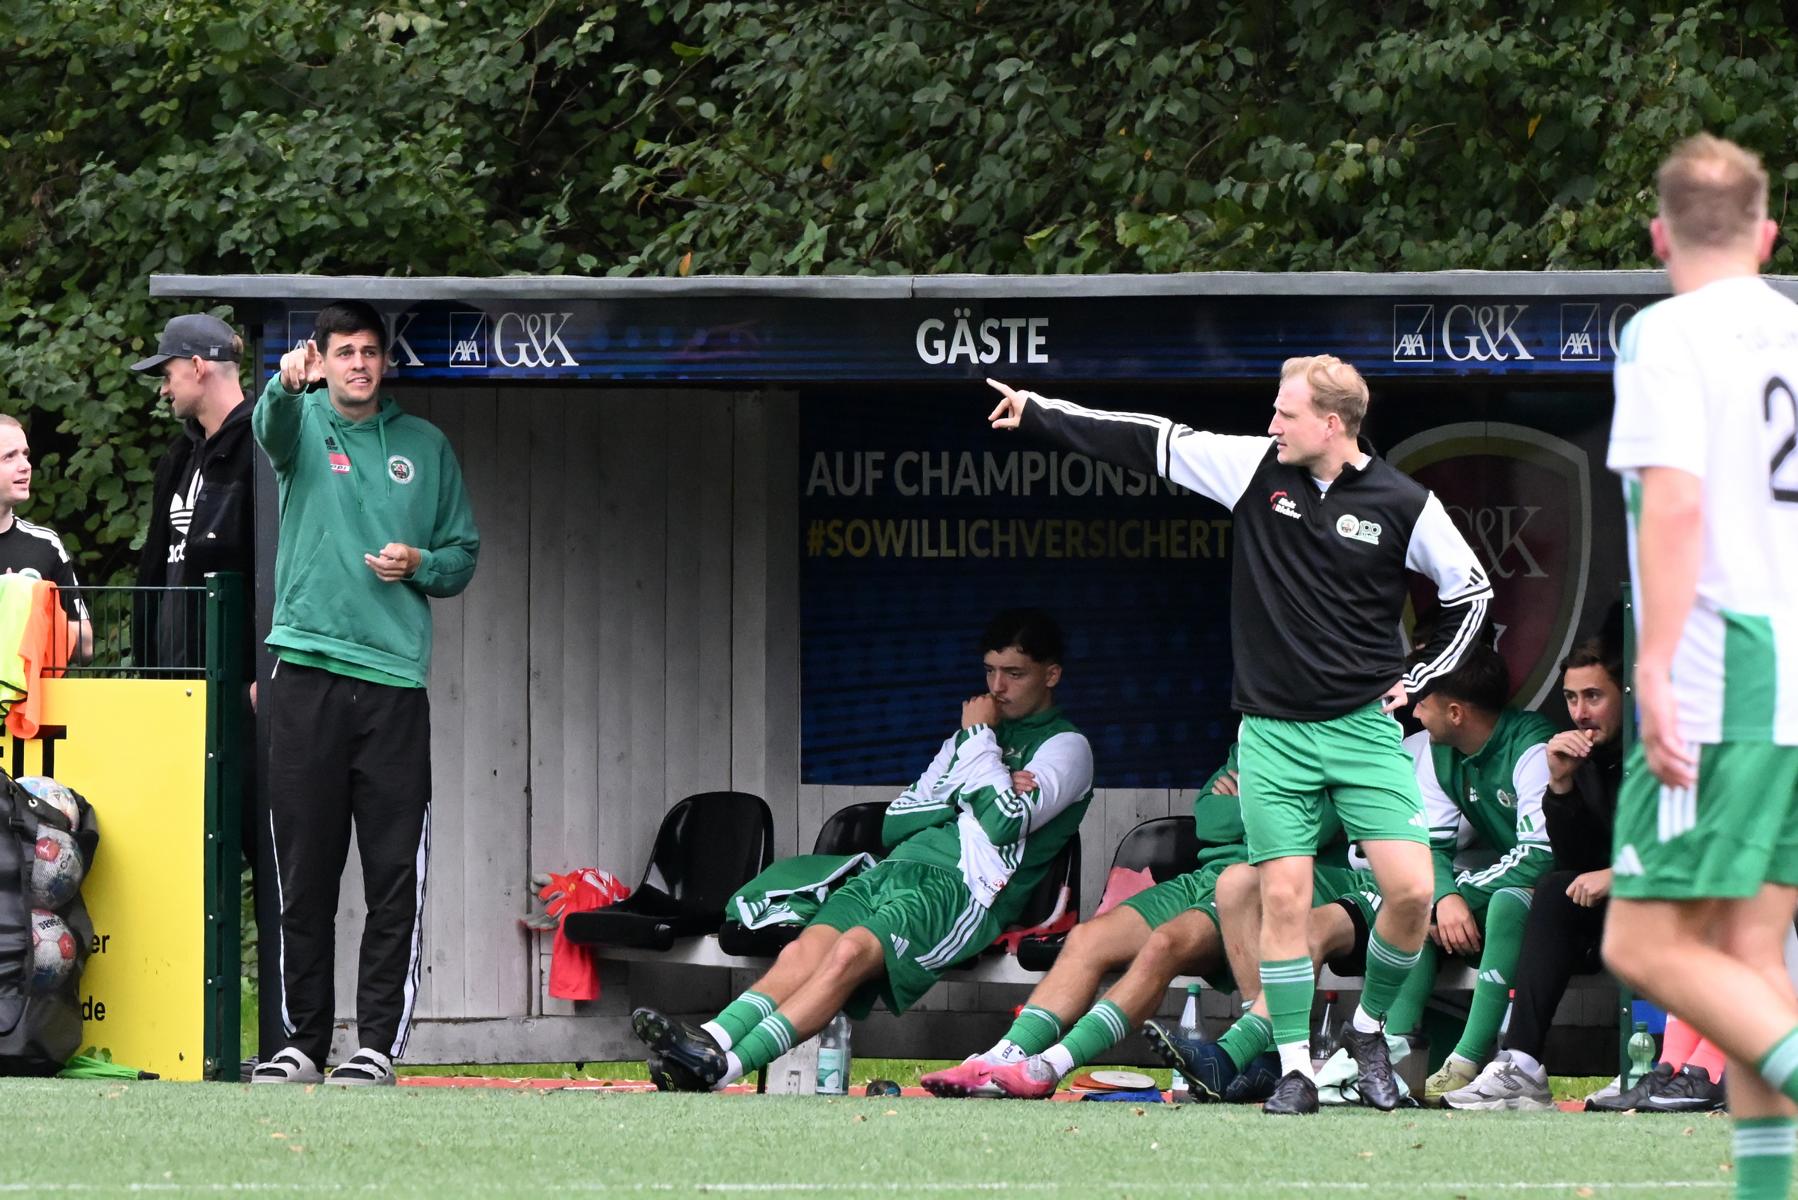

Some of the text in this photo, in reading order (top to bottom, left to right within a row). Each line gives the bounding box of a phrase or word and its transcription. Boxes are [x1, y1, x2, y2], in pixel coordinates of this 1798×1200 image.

[450, 312, 580, 368] AXA G&K
[916, 307, 1049, 365] GÄSTE
[1394, 304, 1535, 362] AXA G&K
[1561, 332, 1593, 355] AXA
[806, 451, 885, 496] AUF
[807, 518, 1233, 559] #SOWILLICHVERSICHERT
